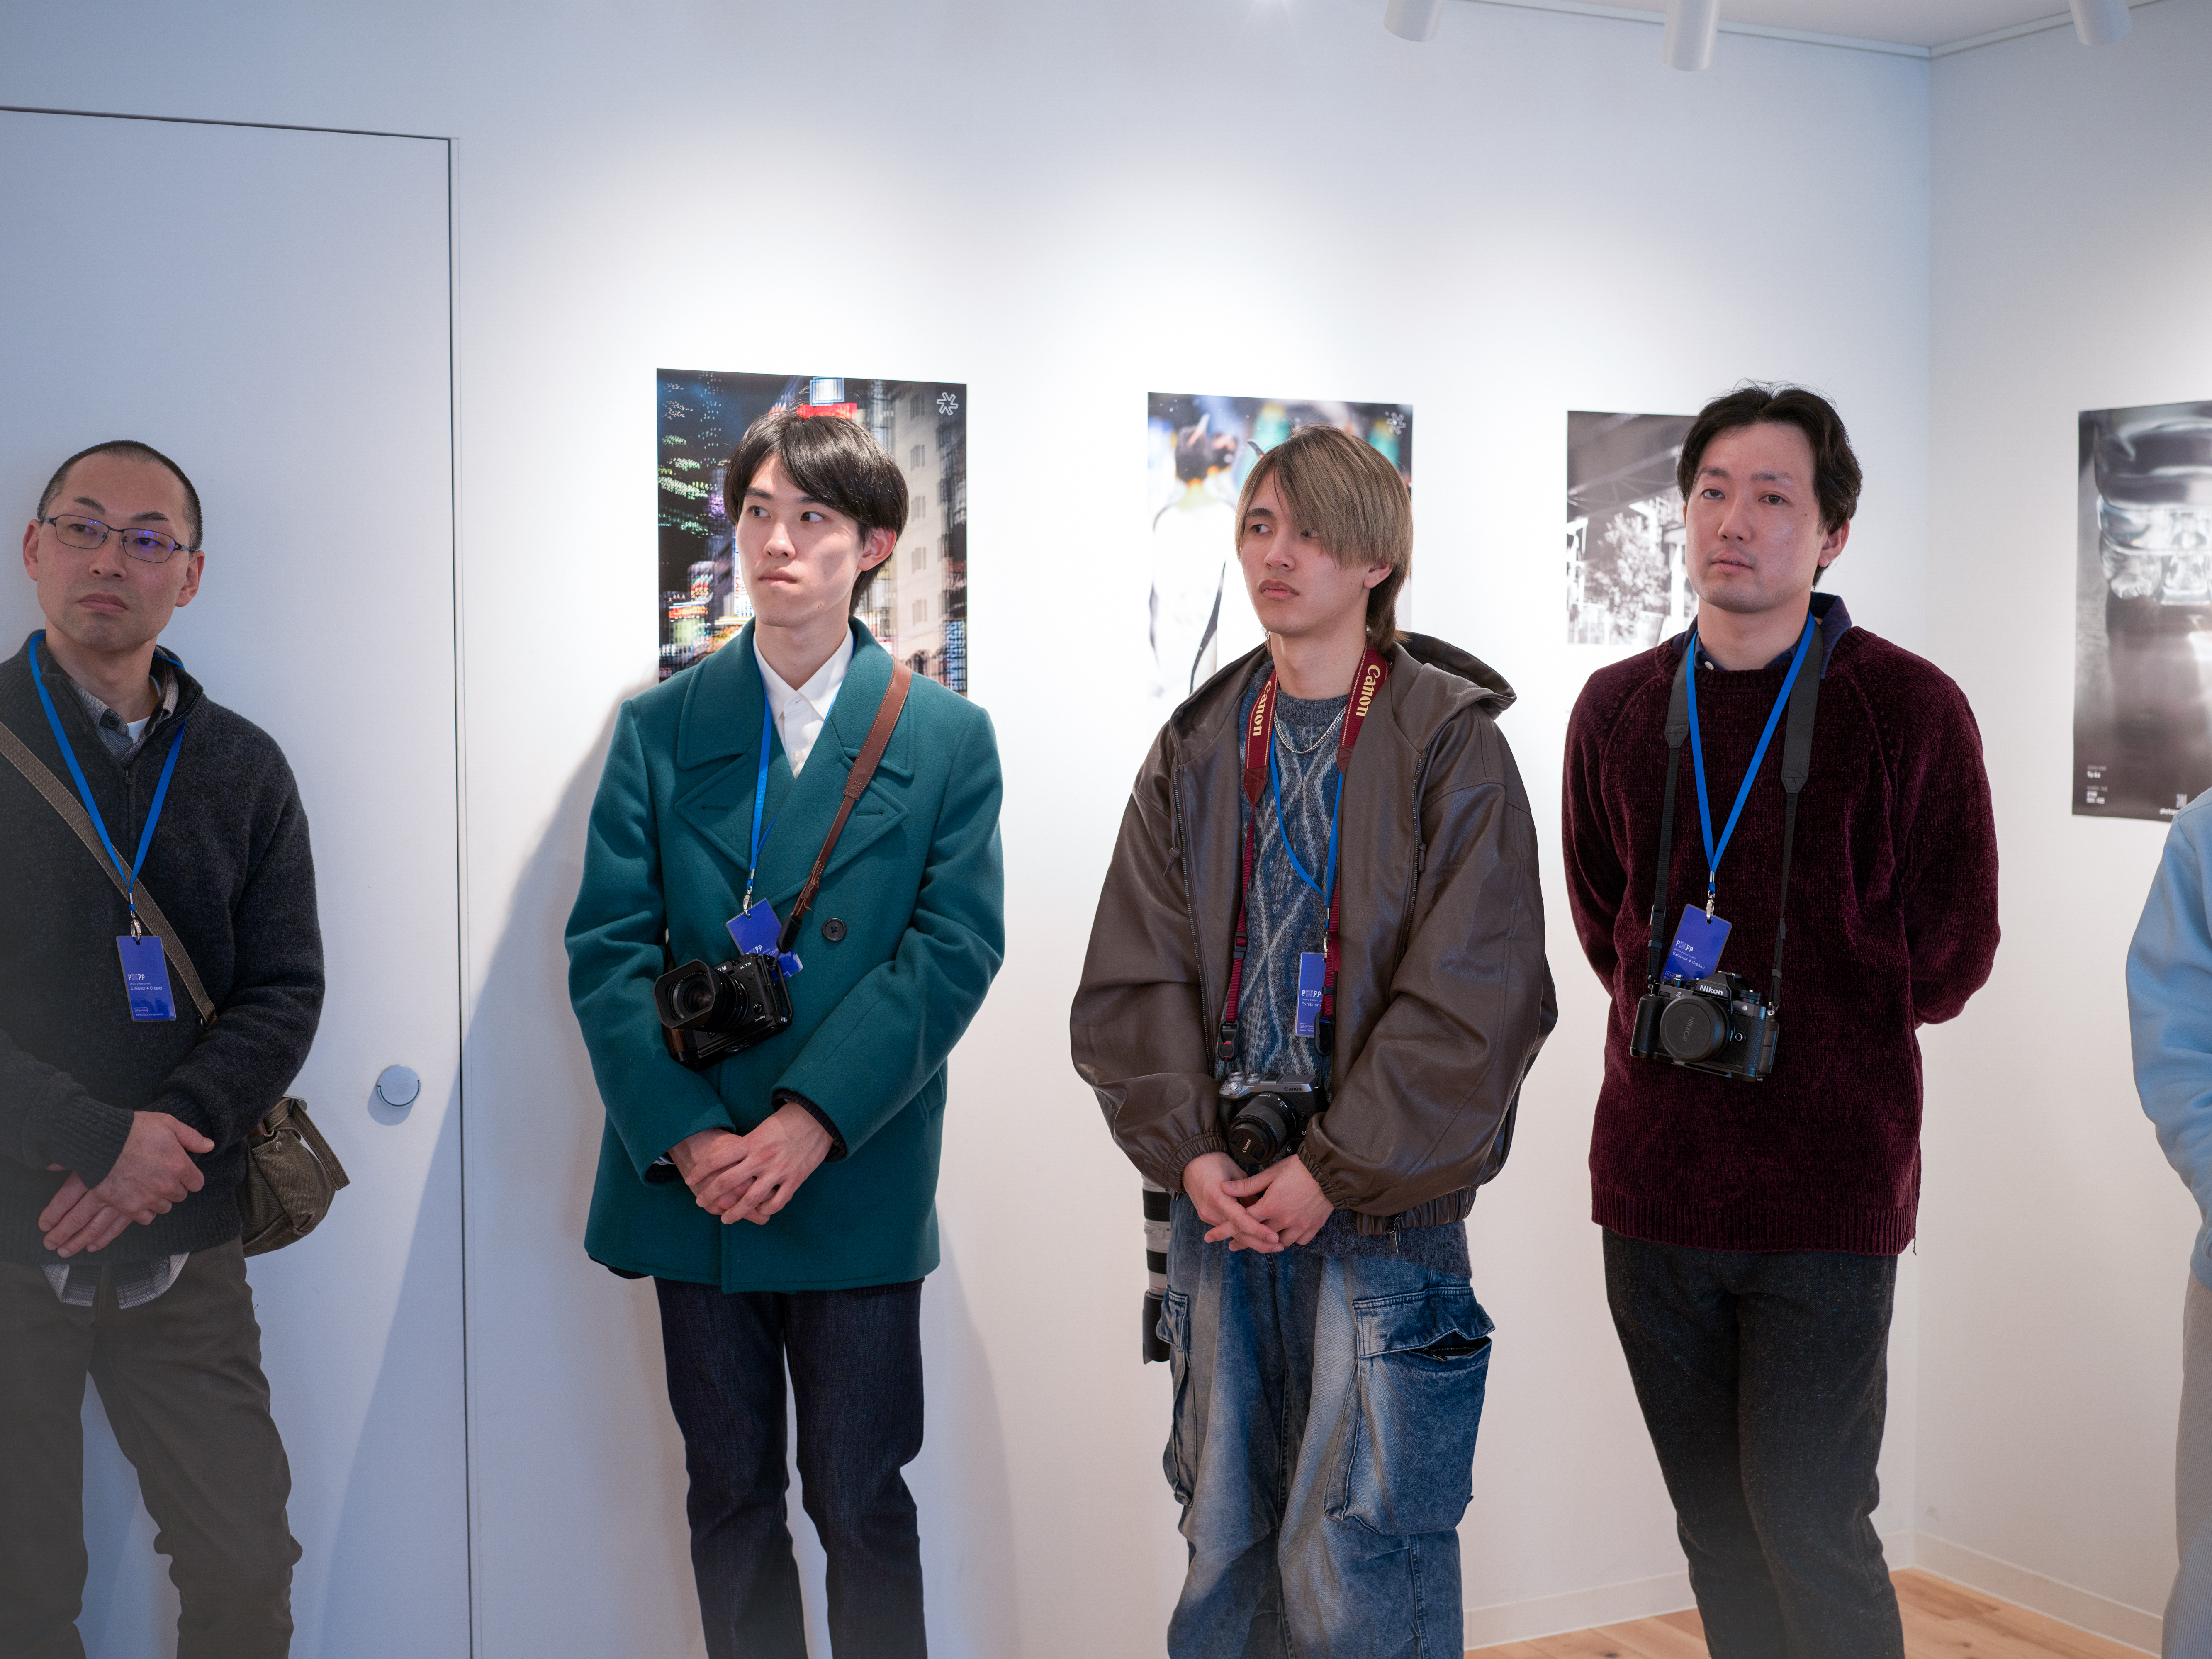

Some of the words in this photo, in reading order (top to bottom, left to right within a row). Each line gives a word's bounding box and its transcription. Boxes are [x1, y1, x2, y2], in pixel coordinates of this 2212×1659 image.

[1355, 664, 1380, 717] Canon
[1253, 680, 1271, 736] Canon
[1672, 951, 1688, 961] Exhibitor
[1692, 961, 1706, 969] Creator
[1699, 985, 1723, 995] Nikon
[1682, 1016, 1695, 1041] NIKKOR
[1242, 1139, 1251, 1153] Canon
